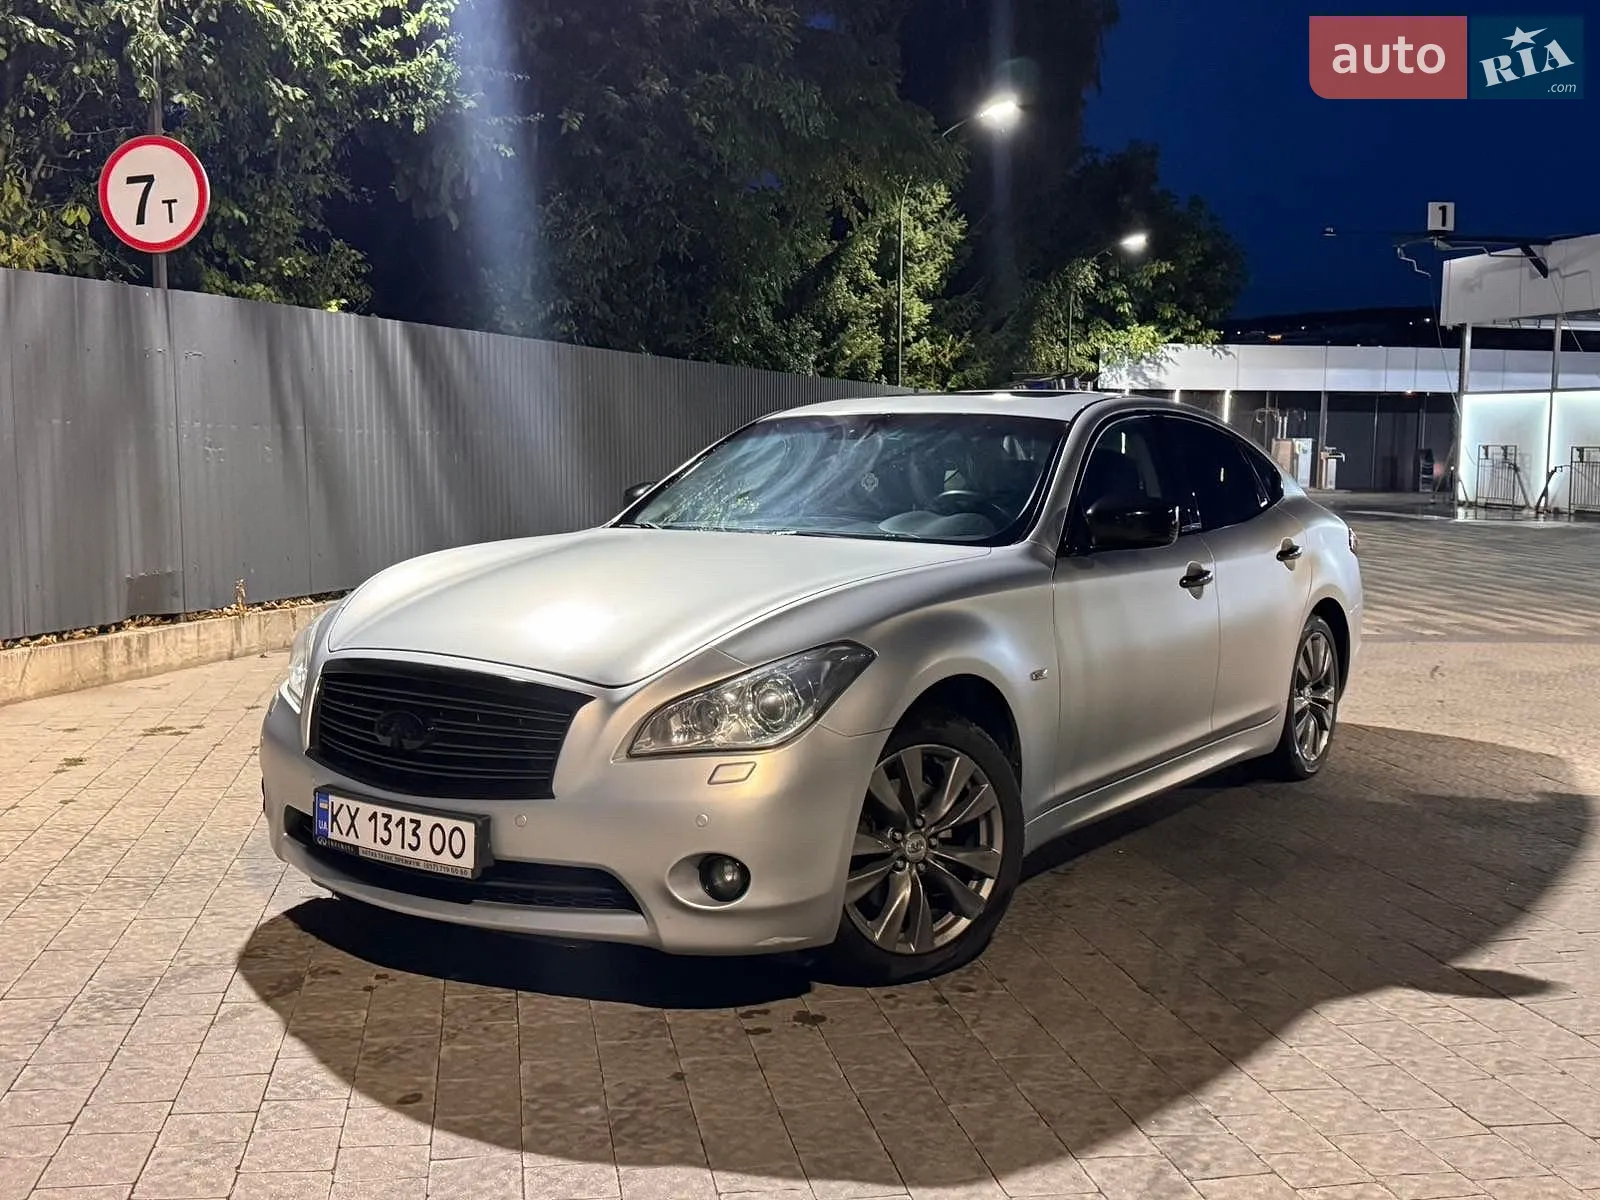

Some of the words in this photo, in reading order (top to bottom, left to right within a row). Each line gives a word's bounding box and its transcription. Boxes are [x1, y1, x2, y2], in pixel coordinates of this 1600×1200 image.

[126, 174, 155, 225] 7
[1438, 205, 1447, 227] 1
[318, 819, 328, 830] UA
[368, 811, 421, 851] 1313
